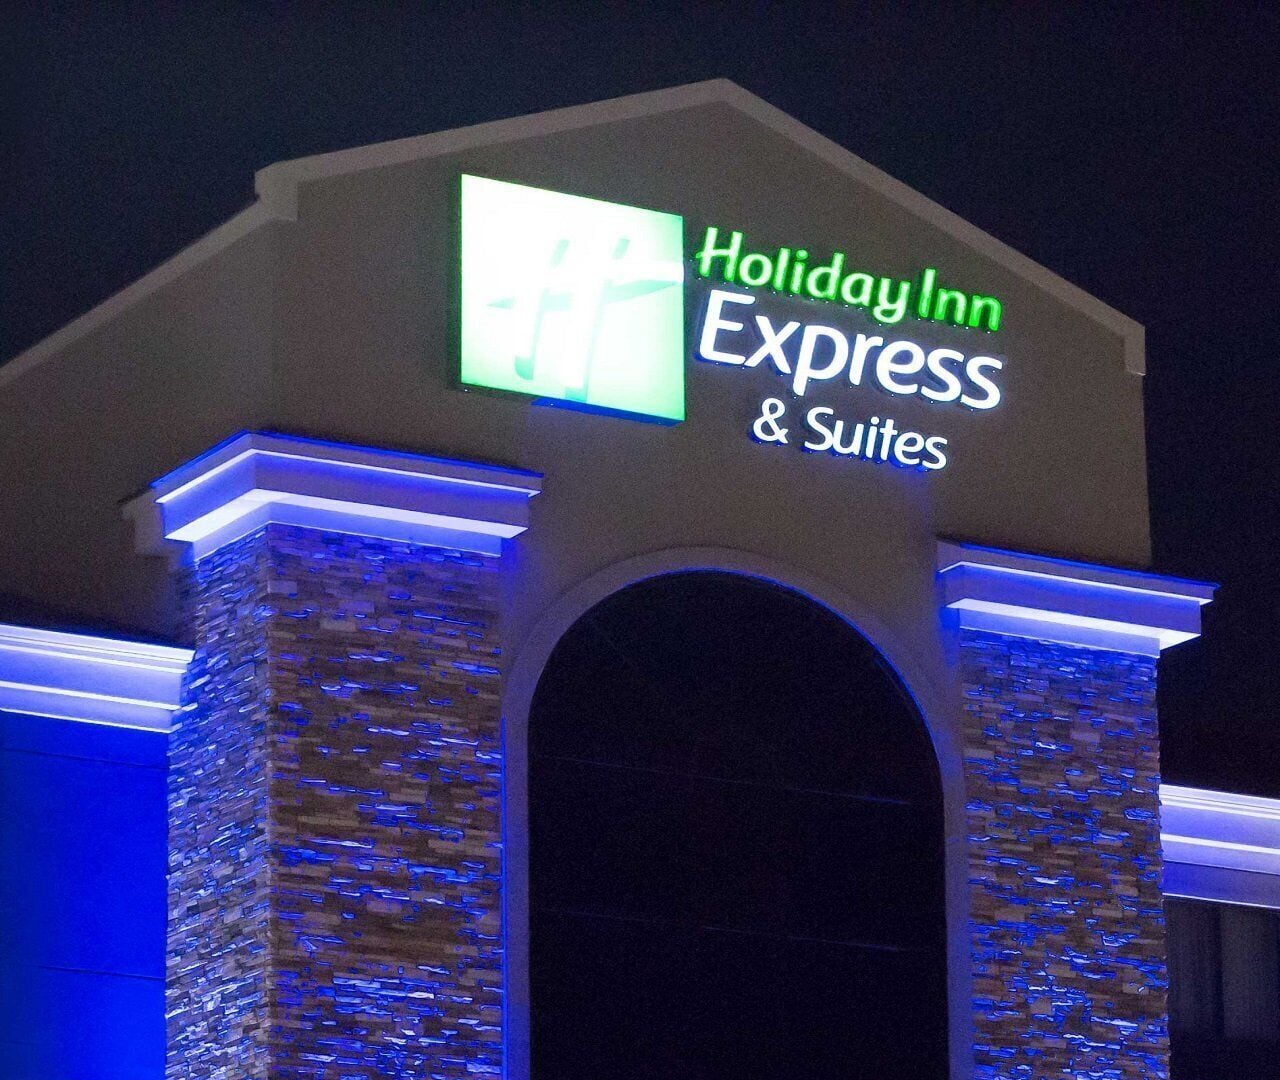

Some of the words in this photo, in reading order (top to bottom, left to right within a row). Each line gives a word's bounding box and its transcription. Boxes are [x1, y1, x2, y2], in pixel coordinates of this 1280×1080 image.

[695, 226, 910, 324] Holiday
[919, 268, 1003, 332] Inn
[697, 288, 1004, 411] Express
[752, 397, 788, 445] &
[803, 405, 949, 471] Suites
